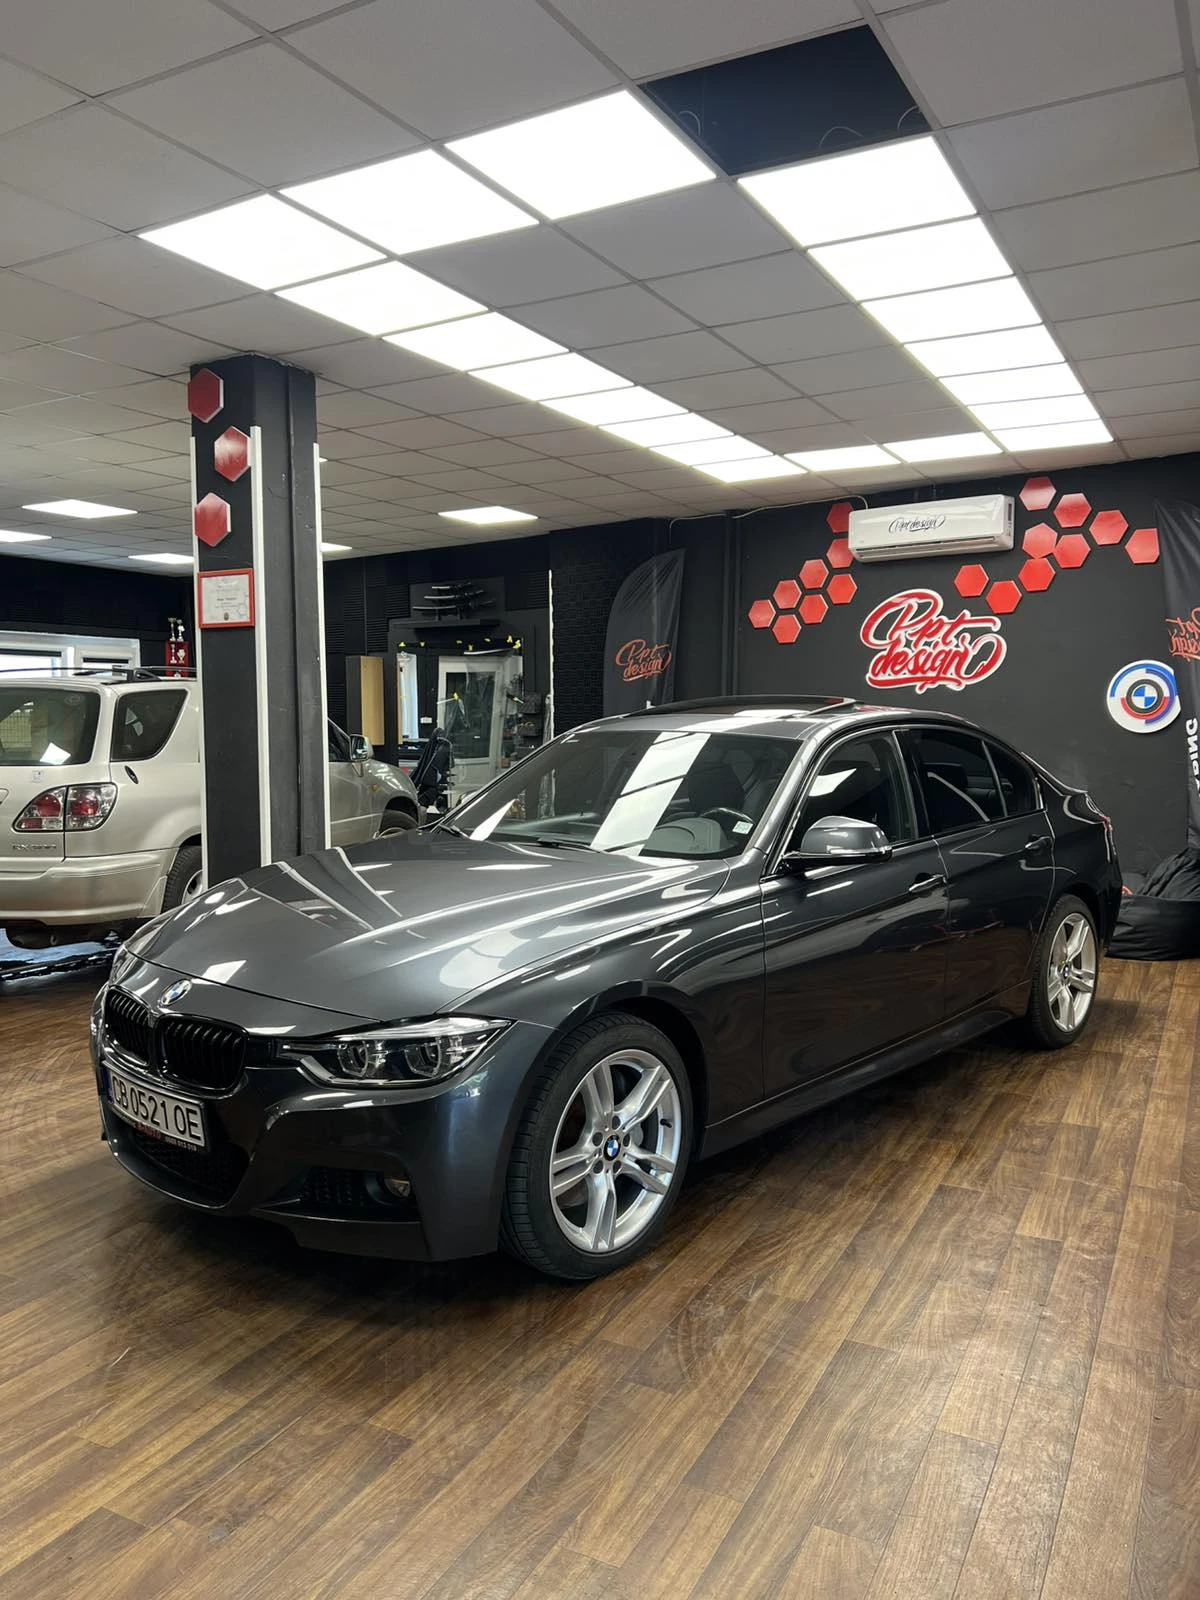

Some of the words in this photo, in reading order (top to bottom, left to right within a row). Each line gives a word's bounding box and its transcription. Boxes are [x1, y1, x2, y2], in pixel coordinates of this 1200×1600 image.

[112, 1075, 128, 1110] CB
[130, 1085, 169, 1130] 0521
[174, 1104, 202, 1141] OE
